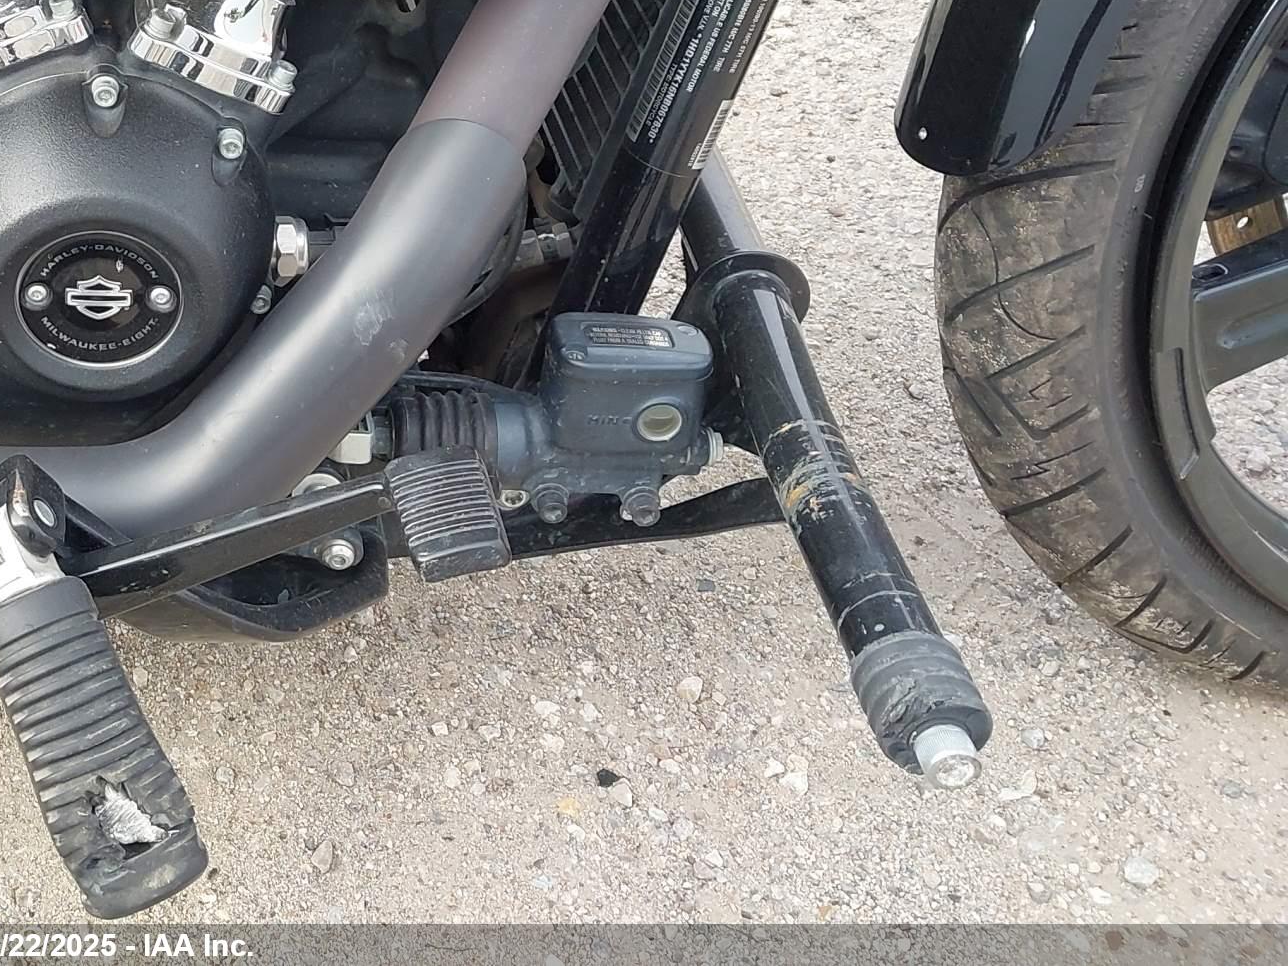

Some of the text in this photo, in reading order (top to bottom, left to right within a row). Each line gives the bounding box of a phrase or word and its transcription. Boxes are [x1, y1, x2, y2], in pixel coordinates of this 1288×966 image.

[711, 5, 720, 17] ON
[710, 26, 720, 38] US
[696, 37, 716, 68] FEDERAL
[685, 67, 701, 92] MOTOR
[40, 244, 159, 279] HARLEY-DAVIDSON
[40, 317, 156, 351] MILWAUKEE-EIGHT
